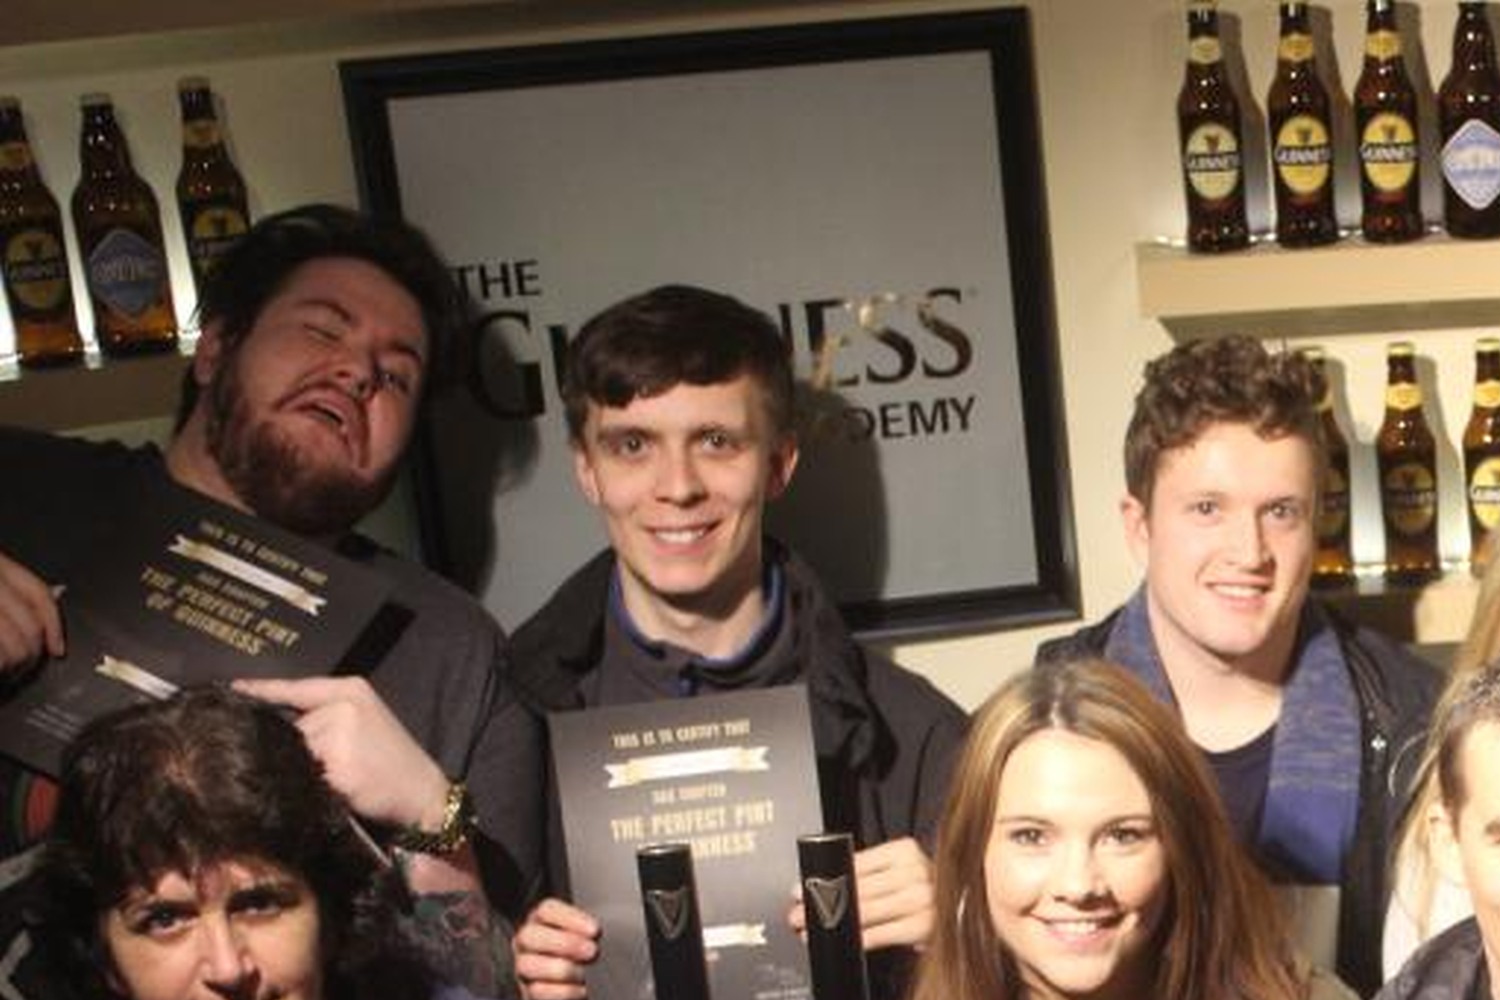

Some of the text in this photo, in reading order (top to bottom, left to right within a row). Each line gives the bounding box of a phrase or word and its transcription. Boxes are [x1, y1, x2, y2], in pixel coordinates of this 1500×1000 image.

[446, 259, 542, 300] THE
[140, 566, 300, 647] THE PERFECT PINT
[174, 604, 267, 656] GUINNESS
[613, 732, 640, 748] THIS
[643, 730, 656, 747] IS
[658, 728, 674, 745] TO
[724, 718, 750, 737] THAT
[611, 799, 774, 843] THE PERFECT PINT
